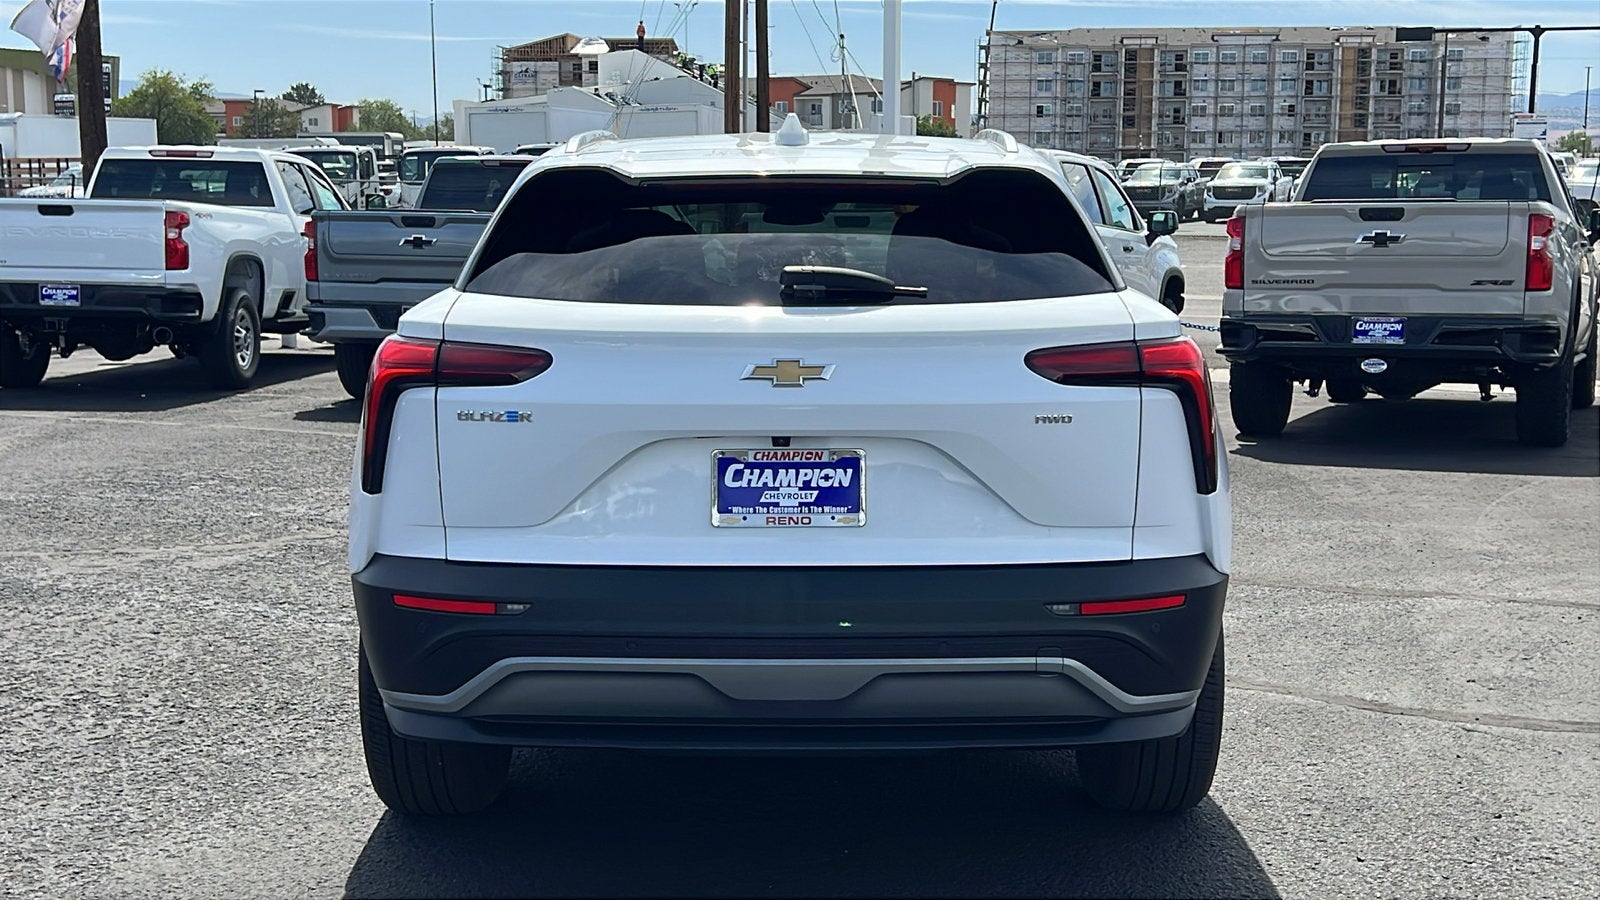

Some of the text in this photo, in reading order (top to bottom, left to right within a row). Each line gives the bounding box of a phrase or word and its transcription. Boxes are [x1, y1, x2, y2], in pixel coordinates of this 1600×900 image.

[42, 287, 78, 296] CHAMPION
[1355, 321, 1403, 331] CHAMPION
[457, 409, 533, 423] BLAZER
[1035, 414, 1073, 424] AWD
[753, 451, 824, 461] CHAMPION
[724, 463, 853, 488] CHAMPION
[763, 492, 815, 500] CHEVROLET
[755, 506, 768, 514] The
[769, 506, 801, 514] Customer
[810, 506, 823, 514] The
[766, 516, 812, 525] RENO
